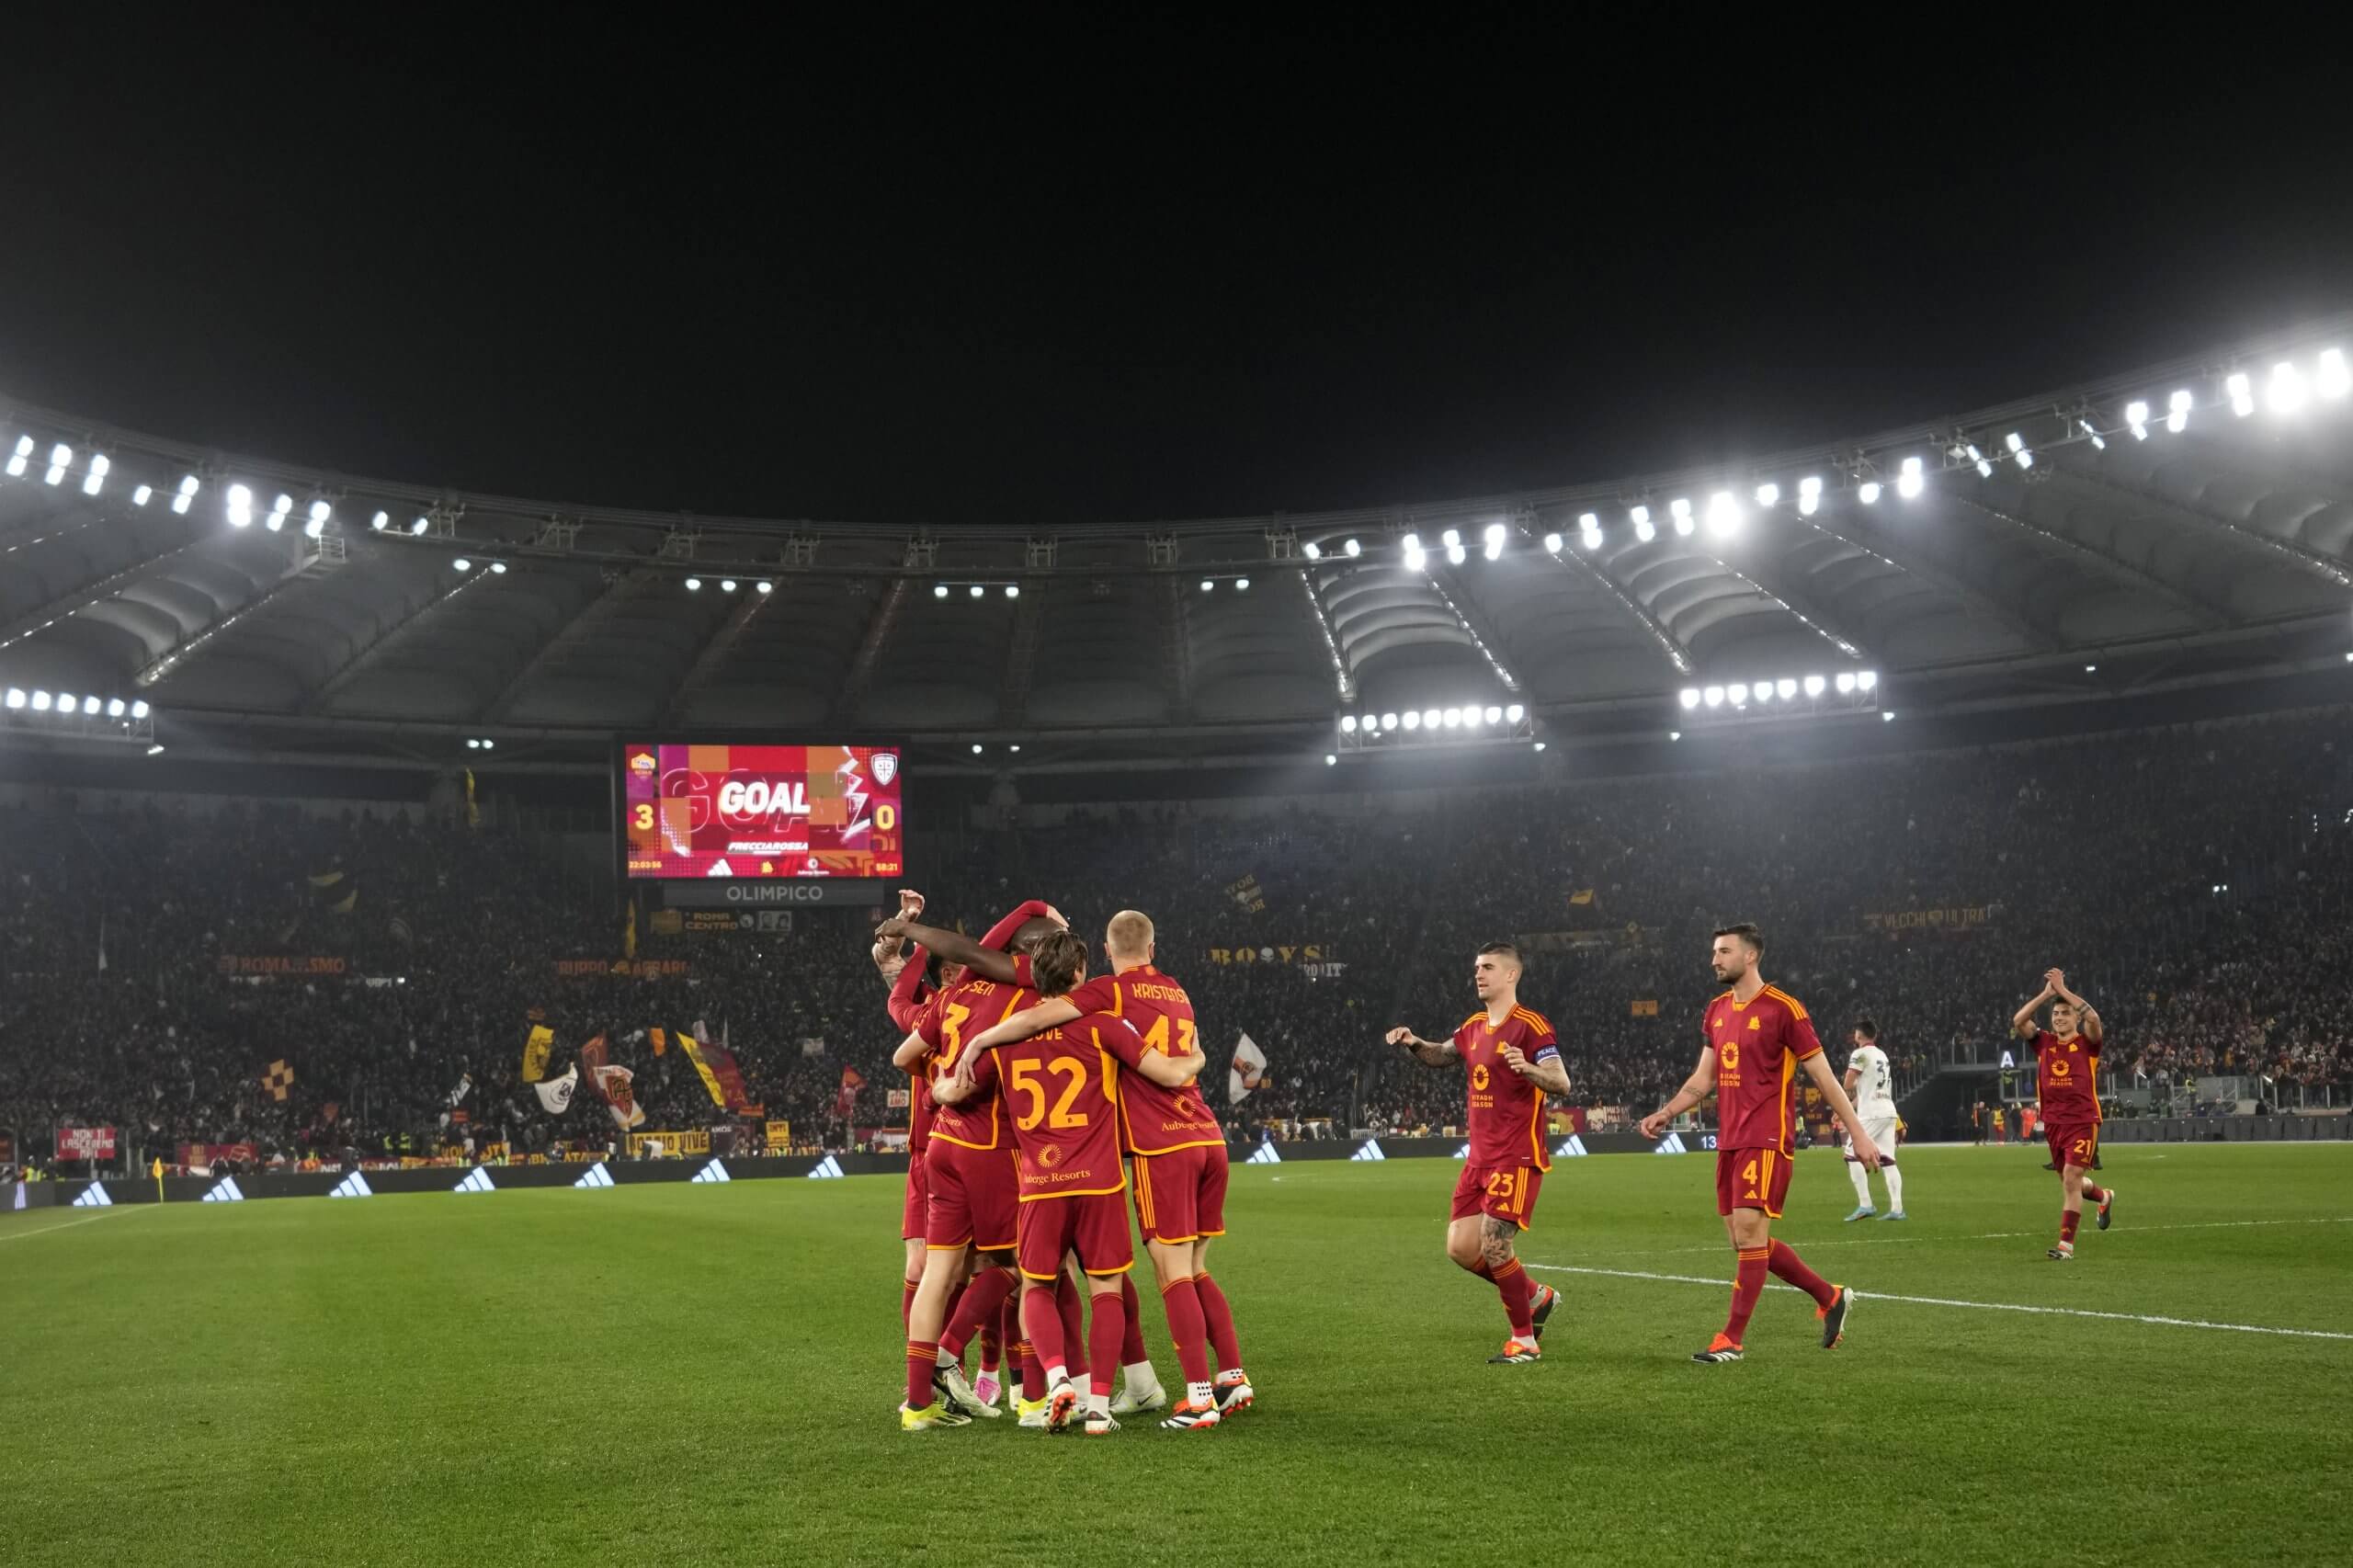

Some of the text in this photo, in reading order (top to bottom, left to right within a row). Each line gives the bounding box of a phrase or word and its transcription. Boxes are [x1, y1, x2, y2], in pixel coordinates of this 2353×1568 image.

[719, 781, 812, 814] GOAL
[635, 804, 654, 830] 3
[876, 805, 894, 830] 0
[728, 842, 809, 851] FRECCIAROSSA
[726, 886, 823, 901] OLIMPICO
[686, 921, 738, 930] CENTRO
[1131, 983, 1190, 1004] KRISTENS
[941, 1002, 971, 1071] 3
[2000, 1051, 2015, 1068] A
[1012, 1056, 1089, 1131] 52
[74, 1129, 106, 1139] NON TI
[680, 1133, 707, 1150] VIVE
[1700, 1136, 1718, 1149] 13
[62, 1139, 115, 1149] LASCEREMO
[2074, 1139, 2092, 1155] 21
[1051, 1170, 1091, 1182] Resorts
[1743, 1161, 1758, 1186] 4
[1487, 1172, 1515, 1197] 23
